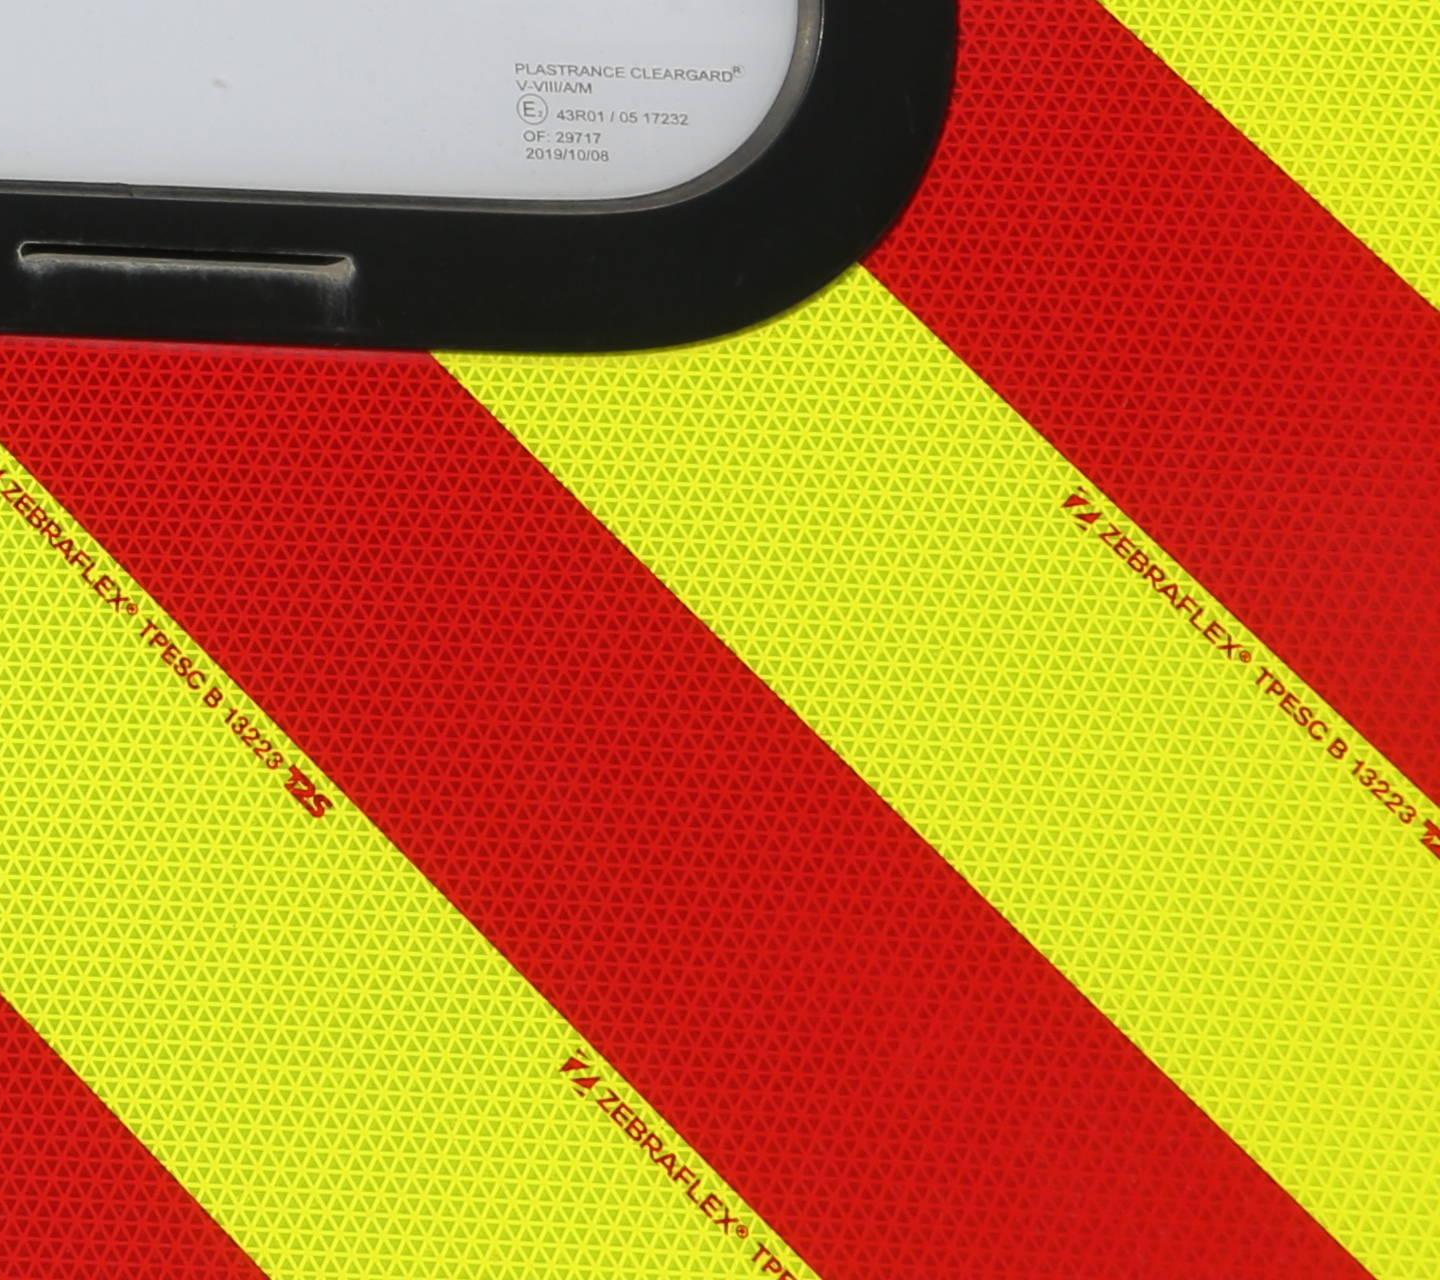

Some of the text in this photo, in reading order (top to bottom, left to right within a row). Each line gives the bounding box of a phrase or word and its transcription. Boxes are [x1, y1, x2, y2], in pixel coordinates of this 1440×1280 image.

[515, 63, 625, 79] PLASTRANCE
[516, 80, 593, 94] V-VIII/A/M
[556, 109, 605, 123] 43R01
[619, 111, 638, 124] 05
[643, 112, 689, 126] 17232
[522, 130, 602, 145] OF: 29717
[525, 147, 610, 162] 2019/10/08
[139, 621, 206, 691] TPESC
[202, 686, 226, 710] B
[224, 706, 286, 772] 13223
[1254, 668, 1330, 742] TPESC
[1327, 737, 1351, 761] B
[1351, 759, 1420, 826] 13223
